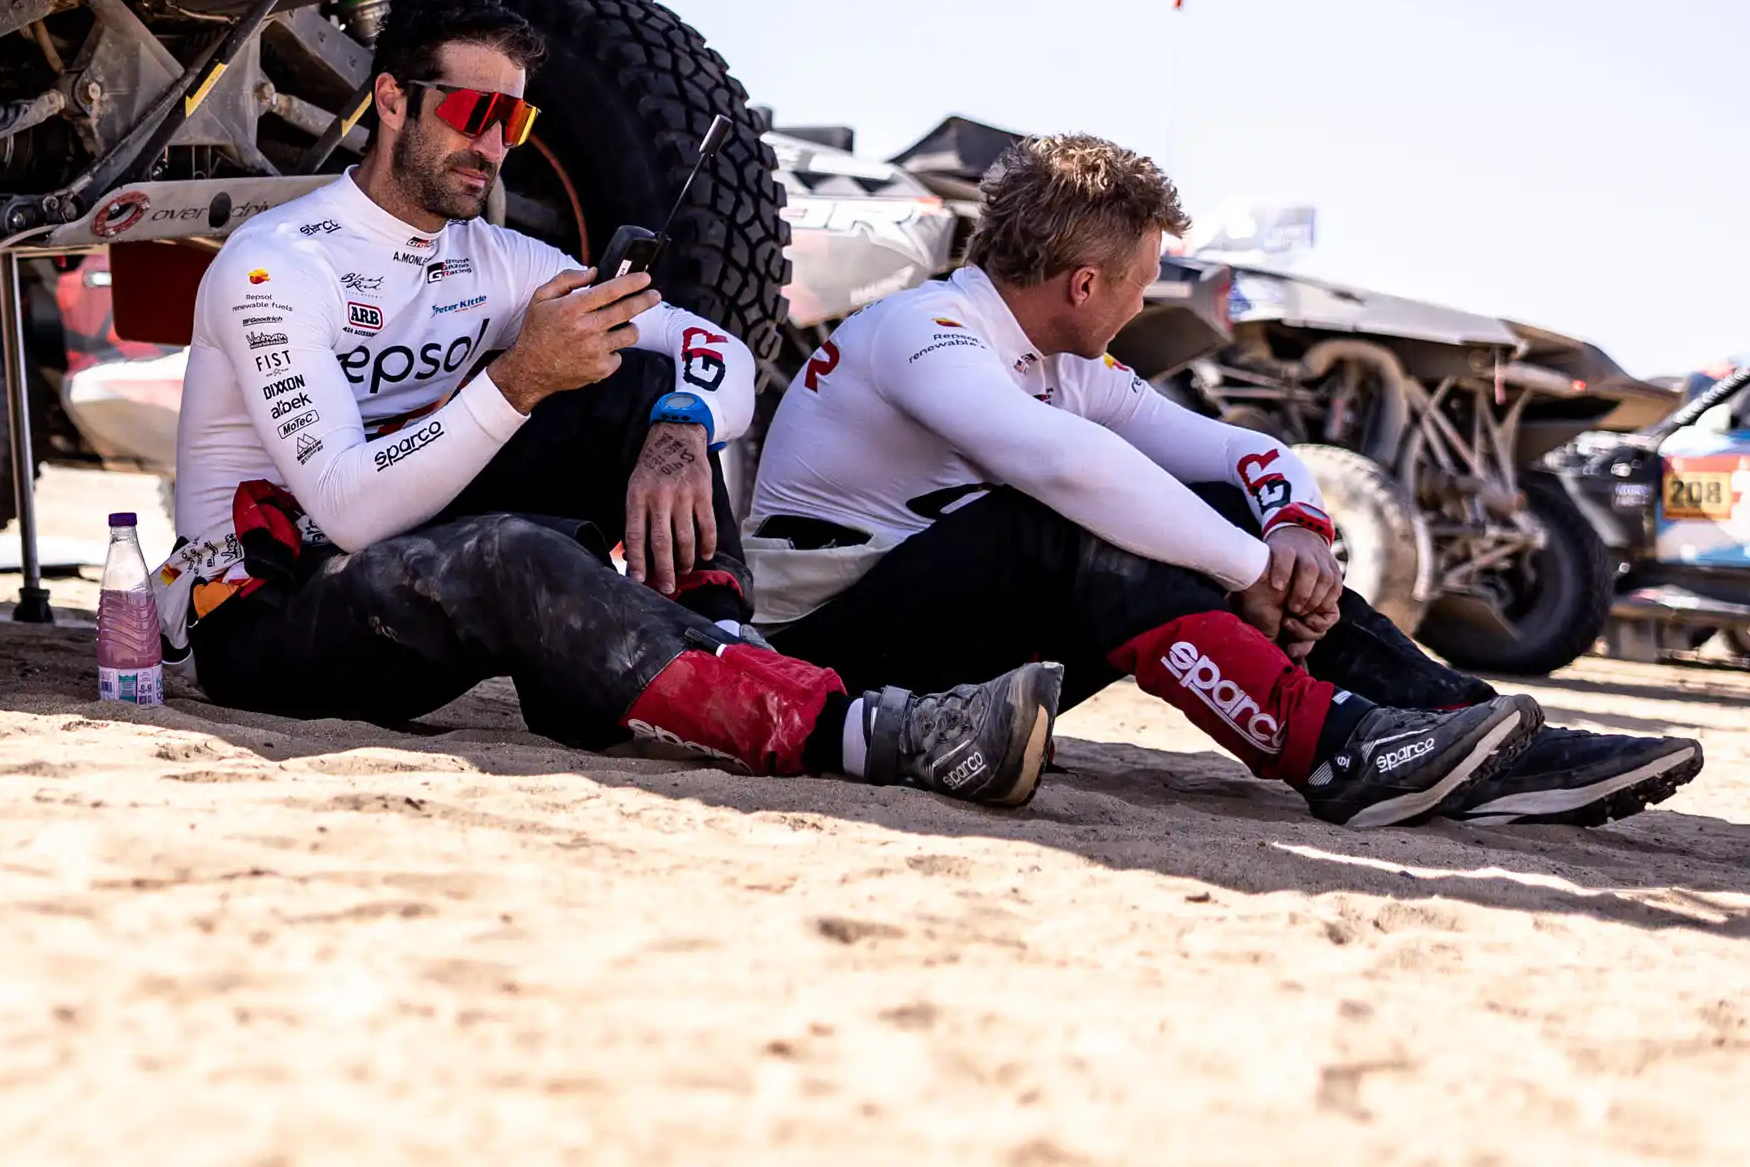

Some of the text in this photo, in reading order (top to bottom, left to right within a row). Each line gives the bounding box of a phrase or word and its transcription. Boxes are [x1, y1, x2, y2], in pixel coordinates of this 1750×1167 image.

[232, 301, 293, 312] renewable fuels
[351, 306, 380, 325] ARB
[255, 350, 291, 372] FIST
[336, 318, 490, 394] epsol
[262, 374, 306, 401] DIXXON
[282, 413, 313, 436] MoTeC
[374, 421, 444, 471] sparco
[1671, 480, 1721, 507] 208
[1376, 737, 1435, 772] sparco
[945, 751, 987, 791] sparco
